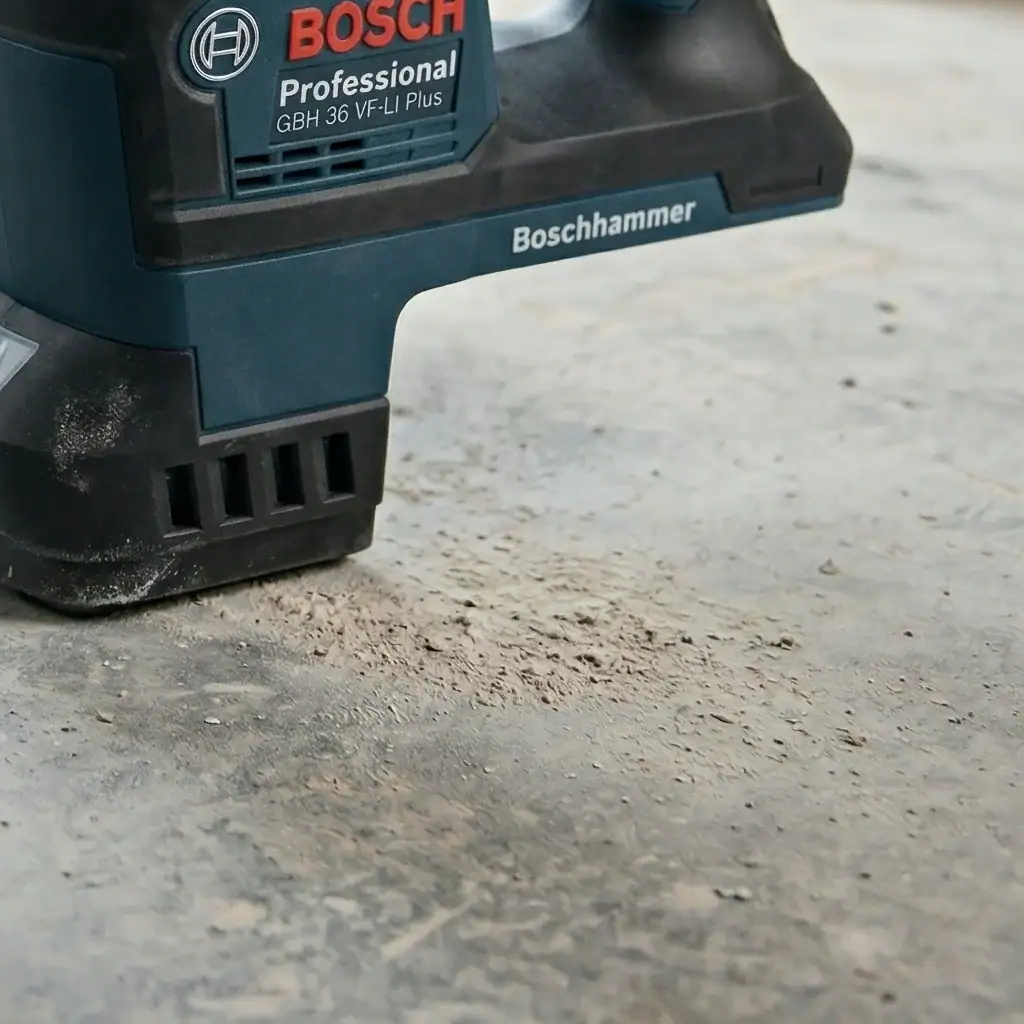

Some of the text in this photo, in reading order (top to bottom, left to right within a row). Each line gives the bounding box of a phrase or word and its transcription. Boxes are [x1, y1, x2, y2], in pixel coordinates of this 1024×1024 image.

[279, 49, 457, 107] Professional
[276, 89, 443, 133] GBH 36 VF-LI Plus
[512, 201, 697, 254] Boschhammer
